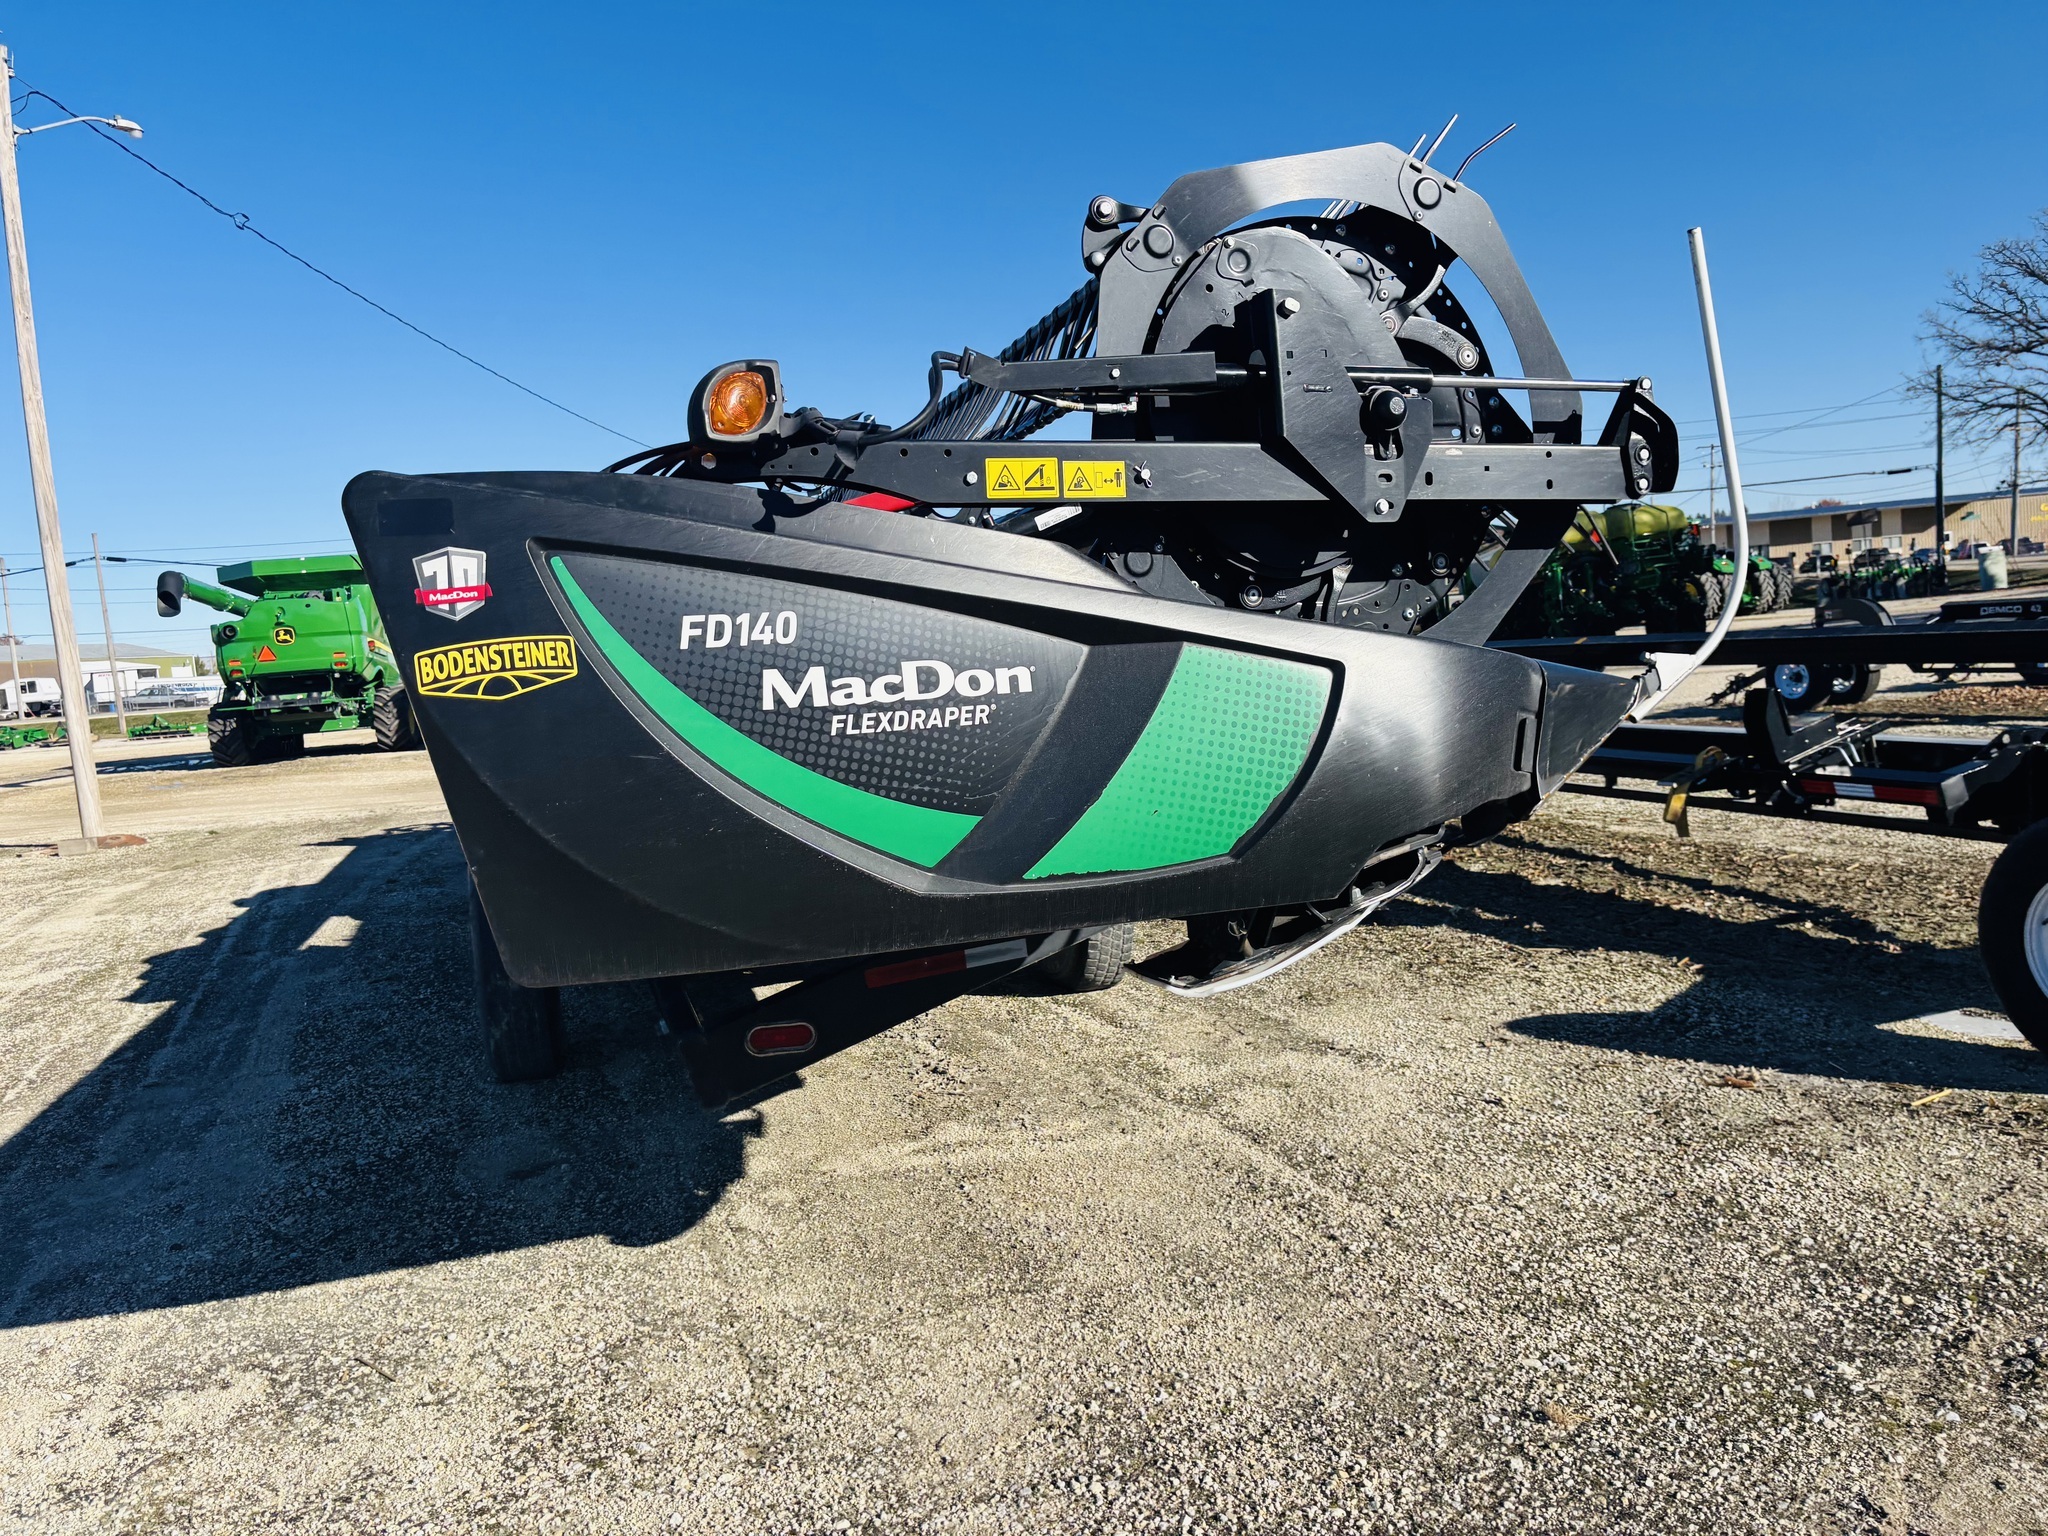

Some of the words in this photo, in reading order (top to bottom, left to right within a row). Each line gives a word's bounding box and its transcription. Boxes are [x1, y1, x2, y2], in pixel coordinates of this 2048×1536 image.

[429, 589, 478, 602] MacDon
[1980, 605, 2023, 616] DEMCO
[680, 610, 798, 650] FD140
[419, 641, 573, 685] BODENSTEINER
[762, 659, 1034, 711] MacDon
[830, 704, 991, 736] FLEXDRAPER
